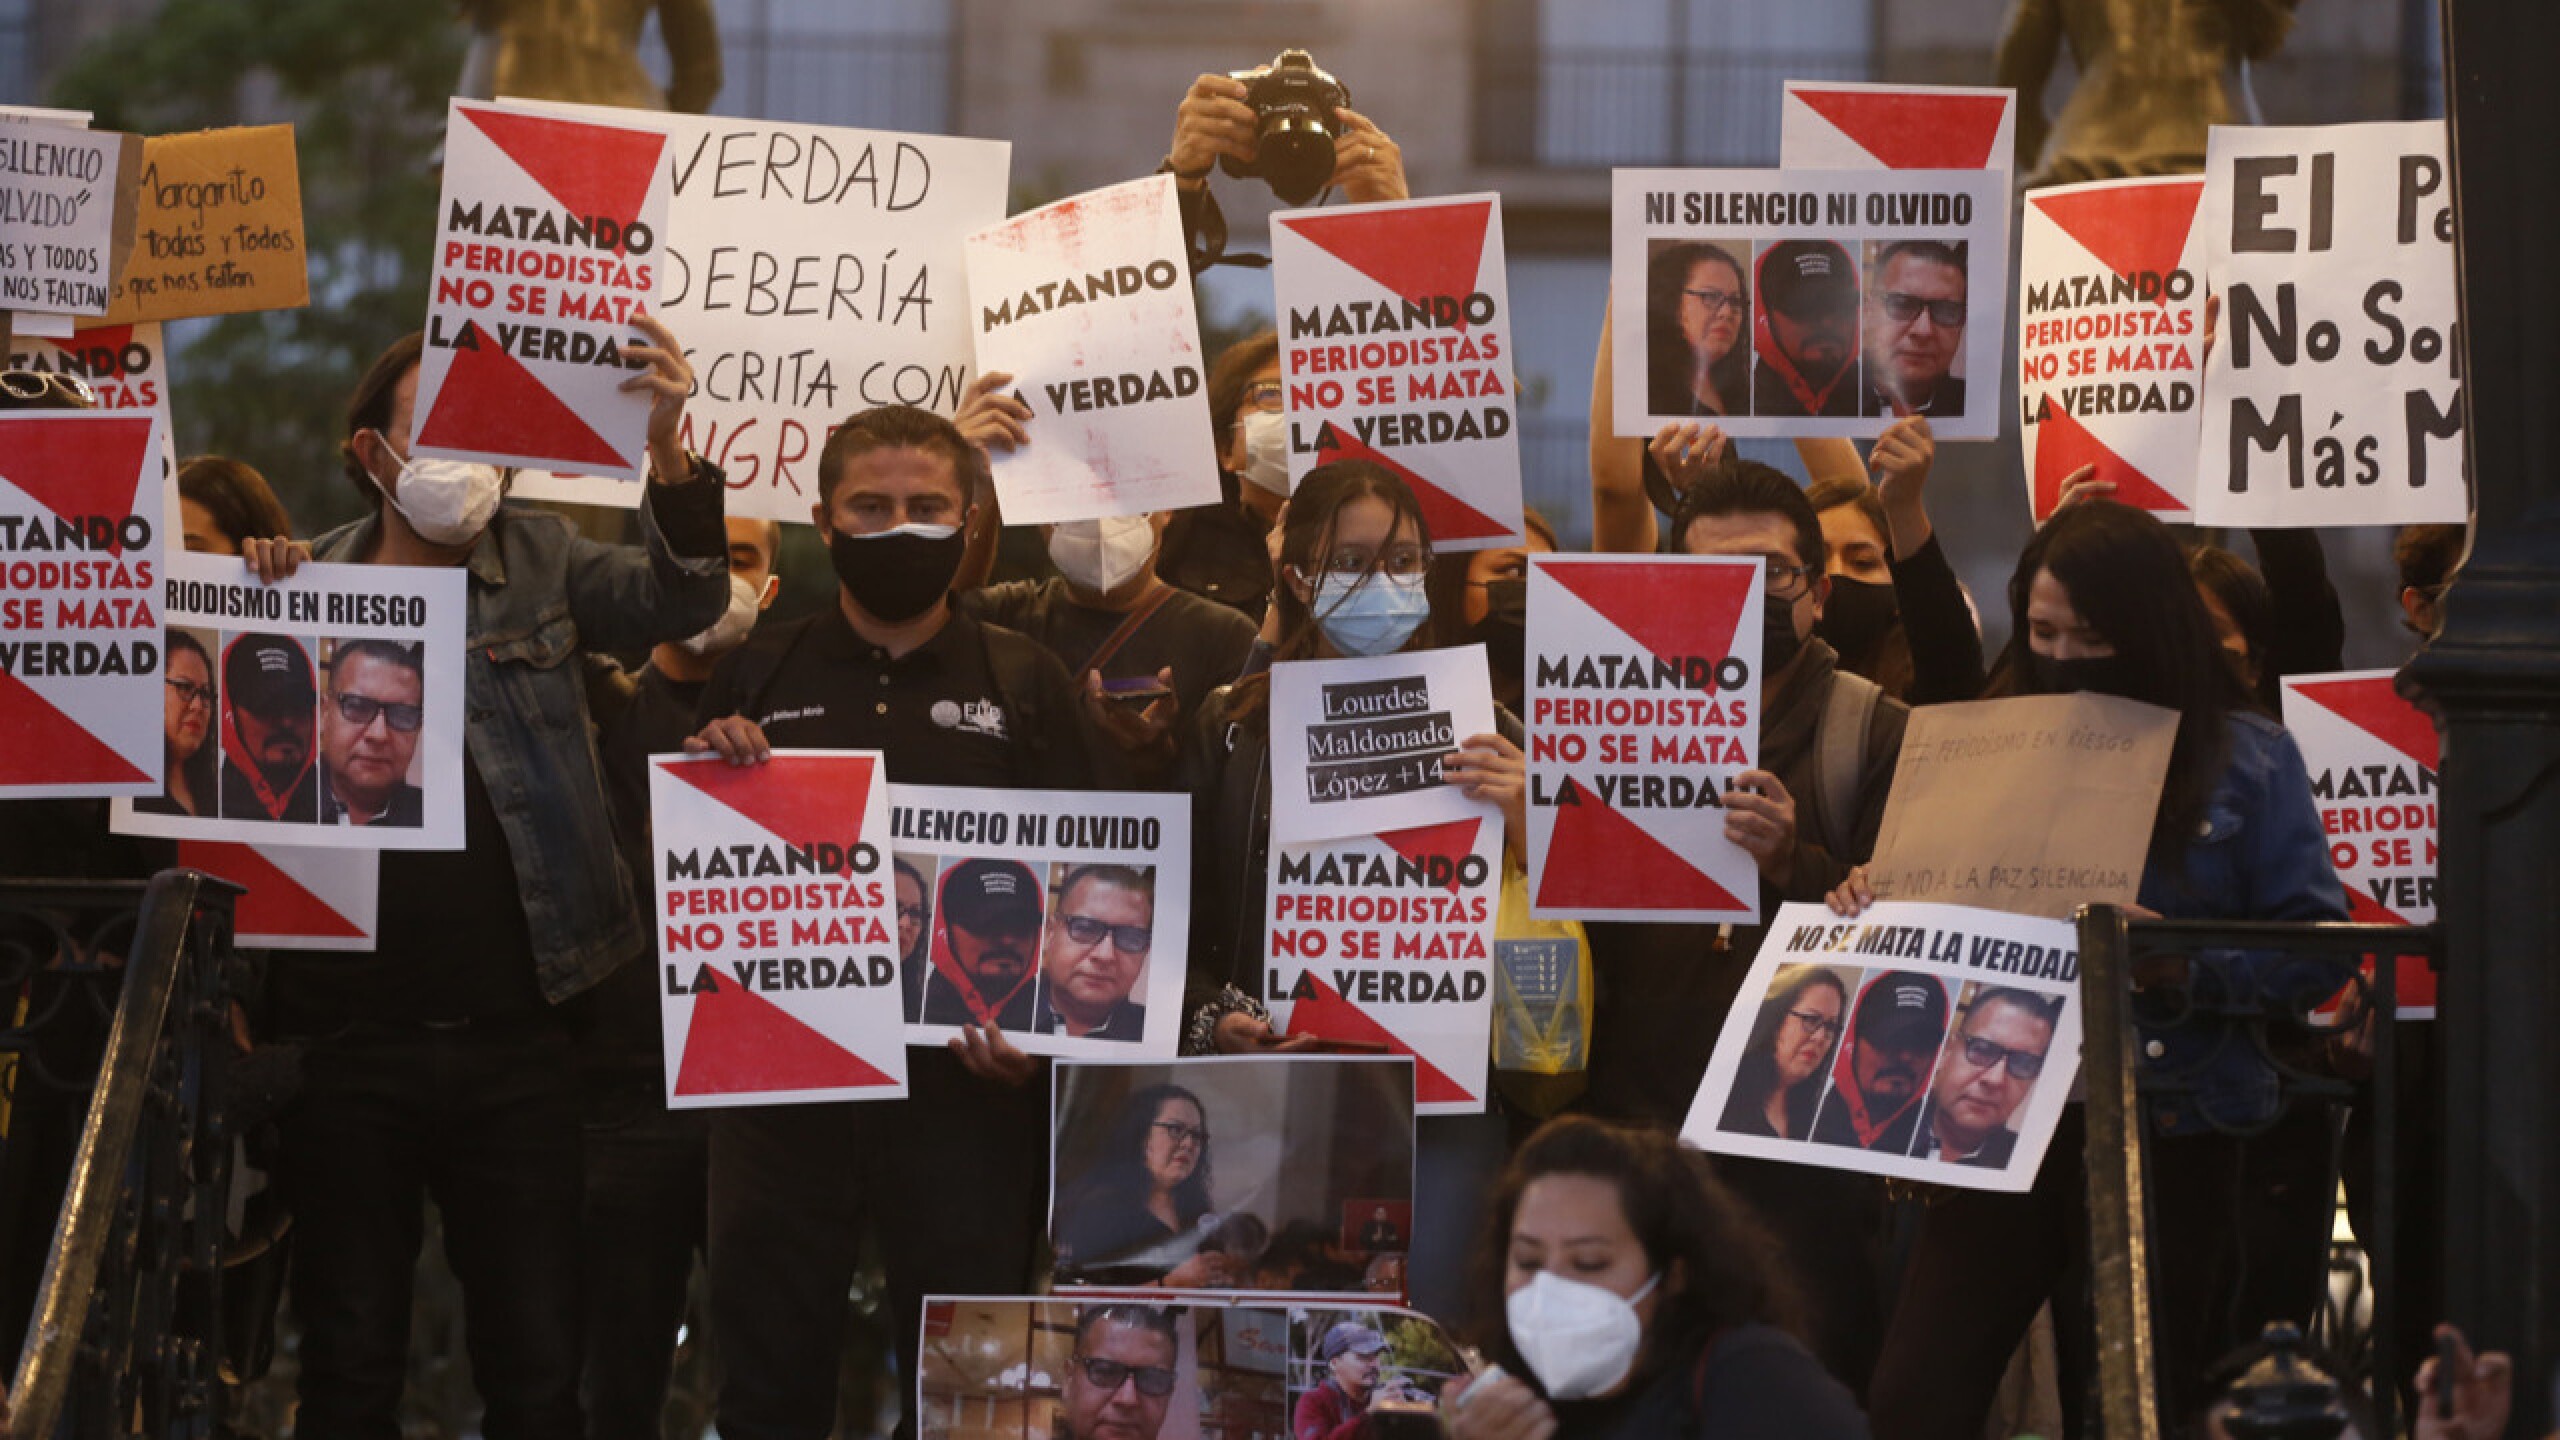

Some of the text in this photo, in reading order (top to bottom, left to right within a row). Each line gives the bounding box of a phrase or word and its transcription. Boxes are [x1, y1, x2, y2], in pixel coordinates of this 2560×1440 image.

[672, 131, 931, 211] VERDAD
[1645, 191, 1973, 226] NI SILENCIO NI OLVIDO
[2231, 152, 2335, 254] El
[448, 197, 654, 256] MATANDO
[23, 243, 36, 271] Y
[43, 244, 99, 274] TODOS
[444, 241, 652, 292] PERIODISTAS
[3, 276, 39, 302] NOS
[44, 278, 108, 314] FALTAN
[437, 275, 495, 309] NO
[505, 283, 547, 315] SE
[982, 259, 1178, 333] MATANDO
[2027, 268, 2195, 315] MATANDO
[429, 314, 480, 352] LA
[1290, 292, 1497, 340] MATANDO
[2025, 308, 2194, 349] PERIODISTAS
[2228, 278, 2342, 370] No
[1290, 333, 1499, 376] PERIODISTAS
[2023, 341, 2194, 384] NO SE MATA
[90, 381, 159, 410] TAS
[859, 360, 967, 412] CON
[1045, 366, 1200, 414] VERDAD
[1290, 367, 1505, 412] NO SE MATA
[2023, 379, 2195, 426] LA VERDAD
[1291, 406, 1511, 454] LA VERDAD
[2227, 392, 2381, 494] Más
[0, 515, 152, 552] TANDO
[3, 598, 156, 630] SE MATA
[164, 578, 427, 627] RIODISMO EN RIESGO
[1536, 654, 1749, 692] MATANDO
[1324, 685, 1429, 717] Lourdes
[1534, 698, 1748, 727] PERIODISTAS
[1308, 719, 1453, 757] Maldonado
[1532, 734, 1750, 765] NO SE MATA
[1309, 770, 1390, 803] López
[1532, 773, 1583, 807] LA
[888, 804, 1161, 851] ILENCIO NI OLVIDO
[667, 840, 880, 882] MATANDO
[1277, 851, 1489, 888] MATANDO
[2370, 838, 2412, 868] SE
[667, 881, 885, 918] PERIODISTAS
[1275, 893, 1488, 924] PERIODISTAS
[666, 914, 891, 953] NO SE MATA
[1271, 928, 1487, 961] NO SE MATA
[1786, 925, 2080, 983] NO SE MATA LA VERDAD
[667, 955, 895, 996] LA VERDAD
[1269, 968, 1318, 1001] LA
[1333, 968, 1487, 1003] VERDAD
